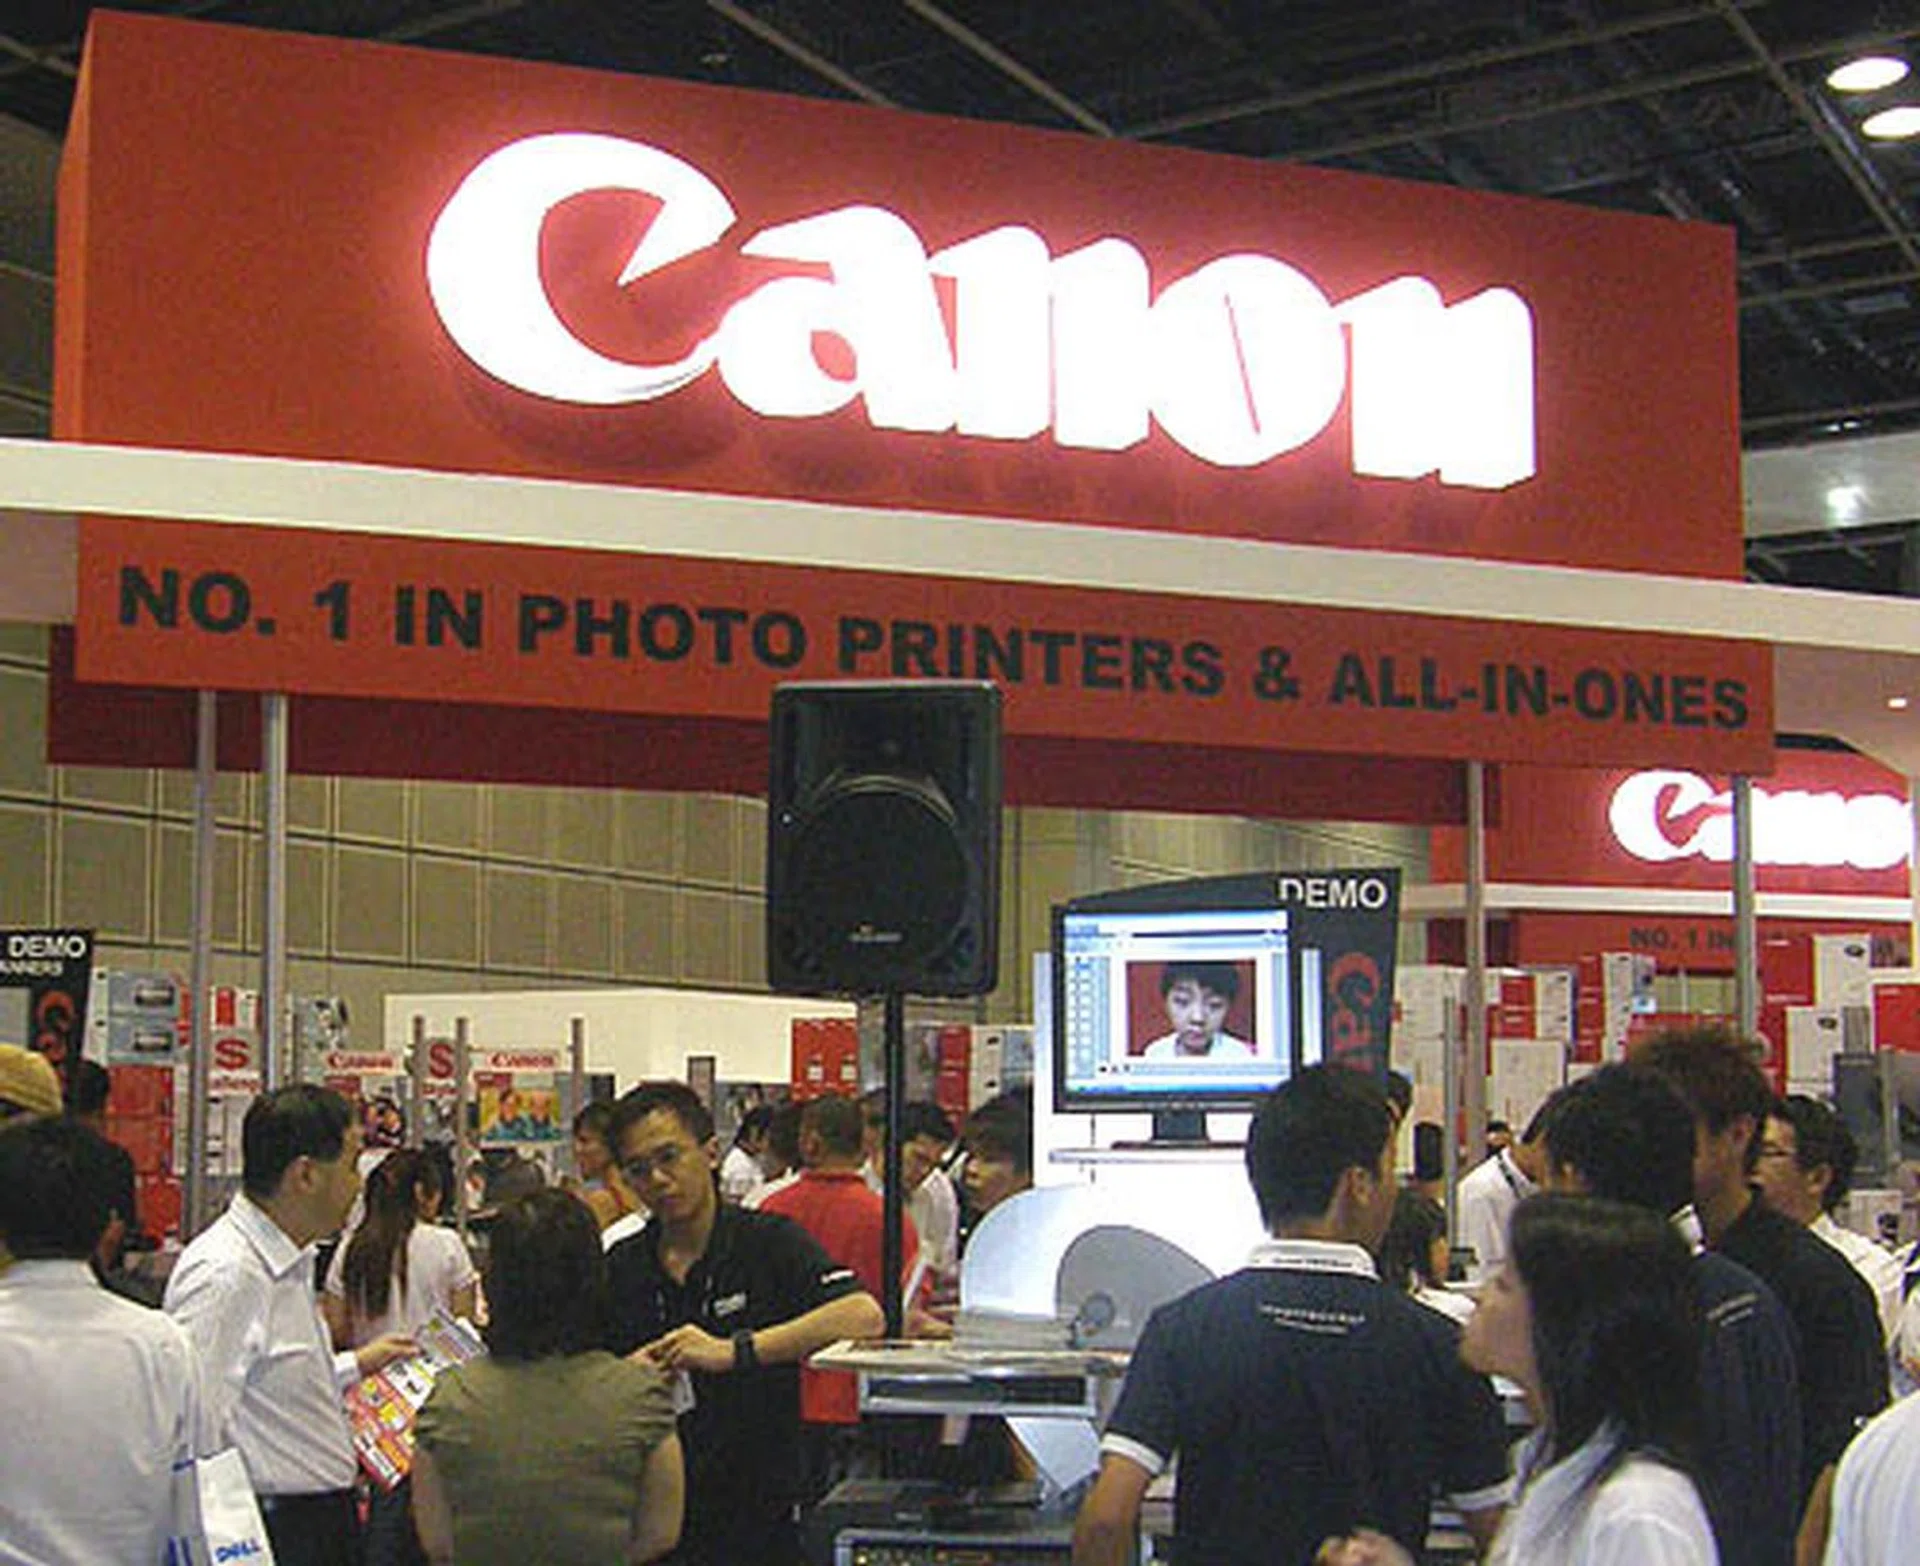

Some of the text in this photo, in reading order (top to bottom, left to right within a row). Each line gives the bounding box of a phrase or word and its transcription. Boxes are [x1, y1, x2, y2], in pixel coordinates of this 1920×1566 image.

[425, 131, 1537, 490] Canon
[118, 565, 1750, 733] NO. 1 IN PHOTO PRINTERS & ALL-IN-ONES
[1278, 877, 1388, 910] DEMO
[8, 935, 87, 959] DEMO
